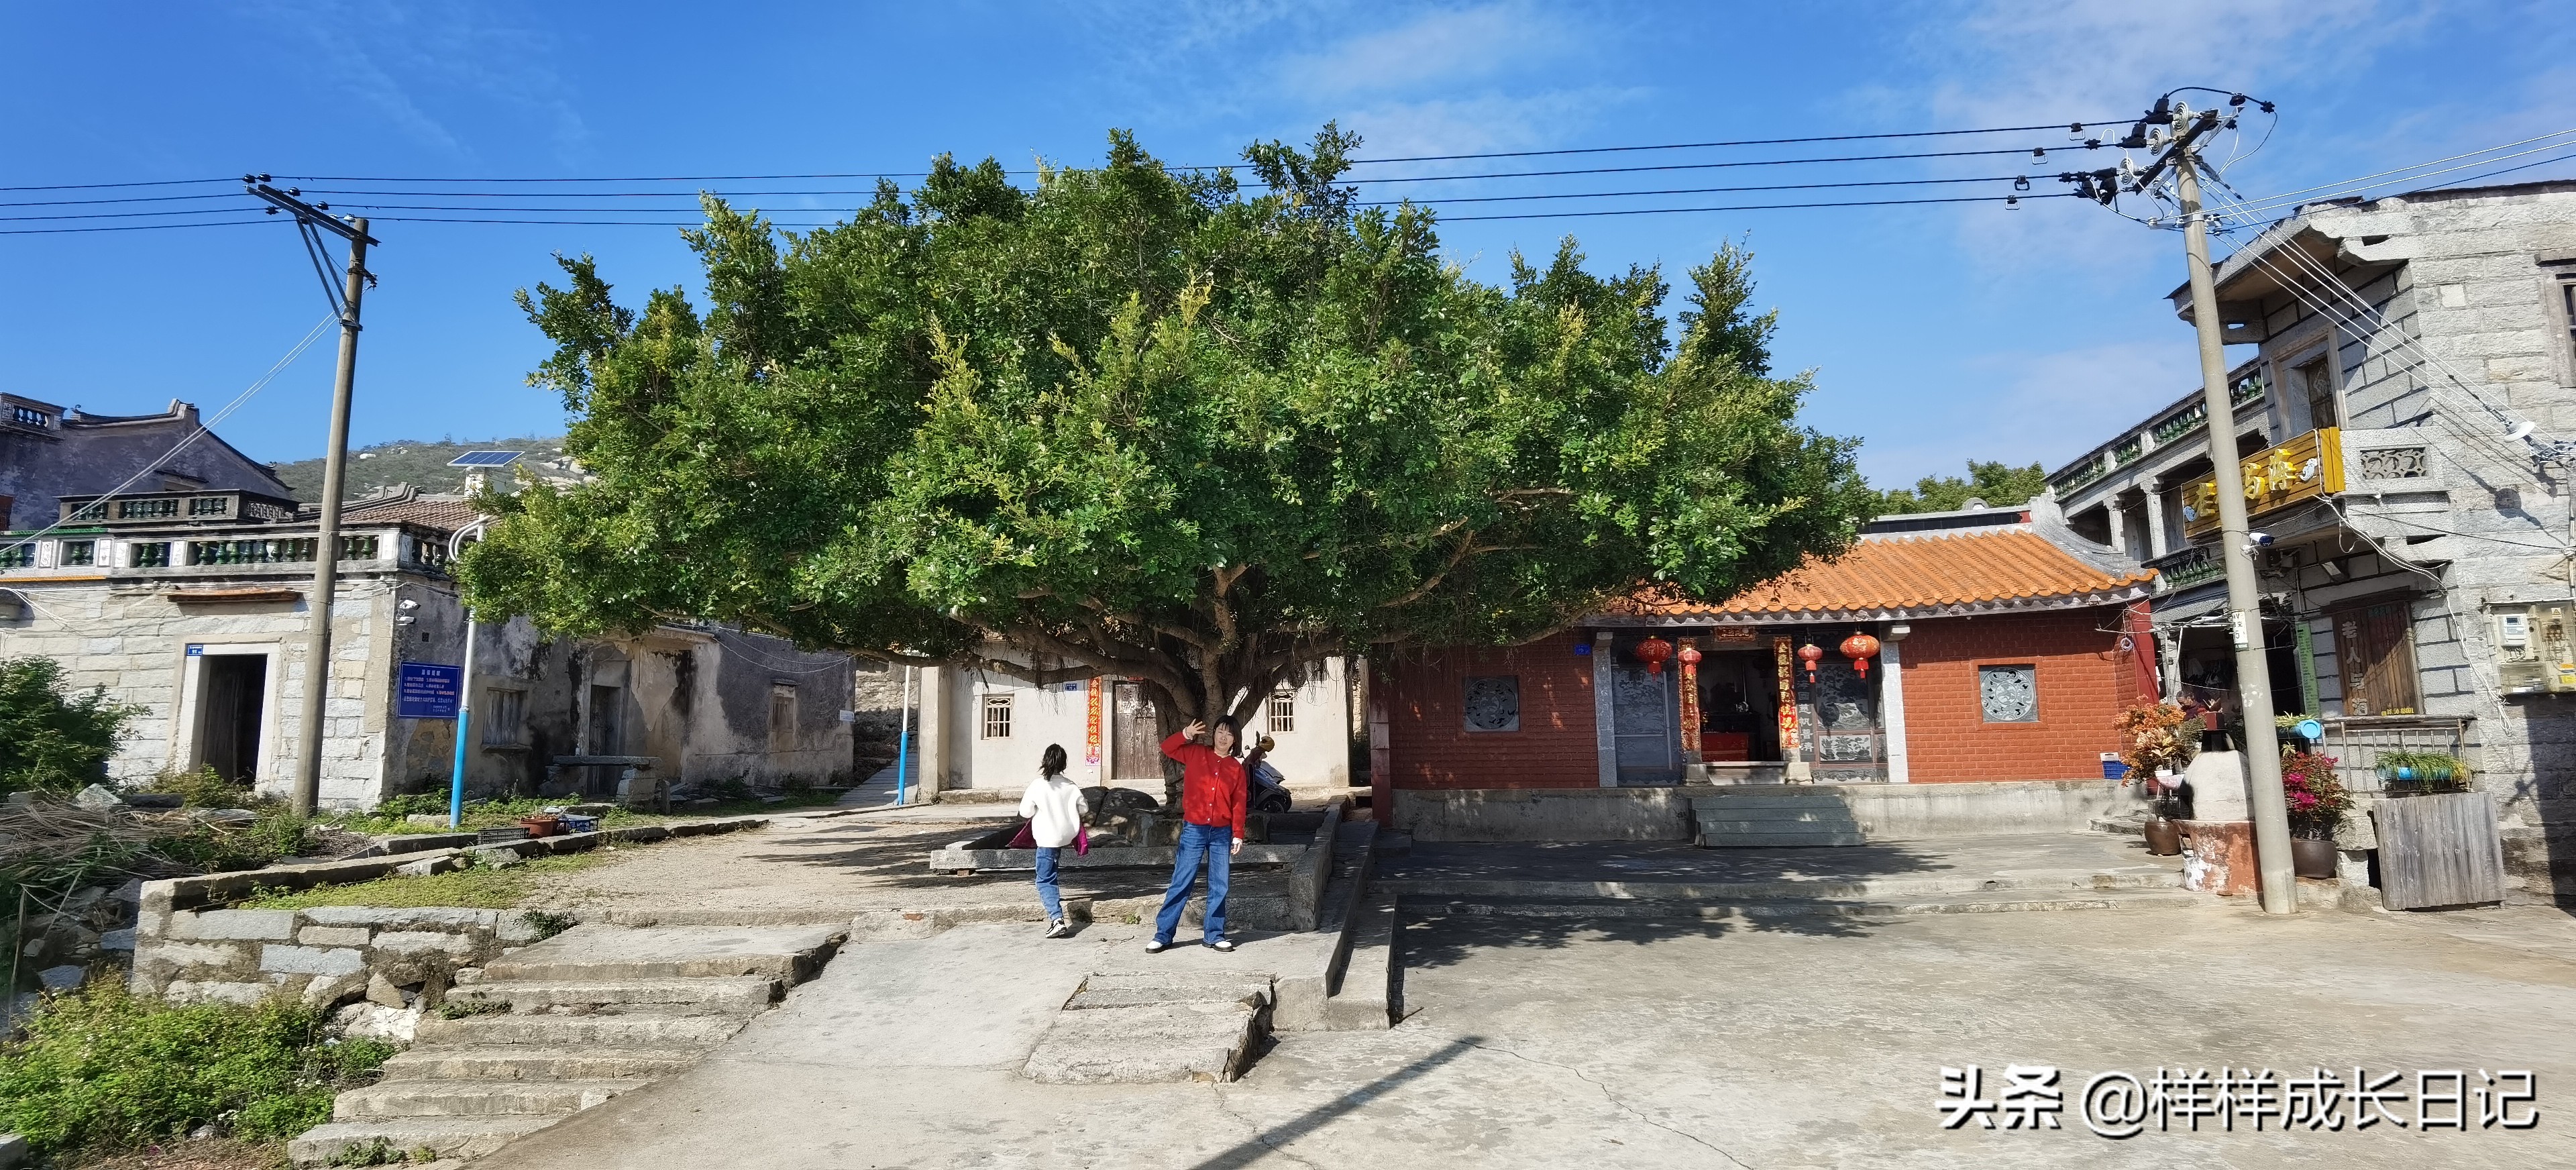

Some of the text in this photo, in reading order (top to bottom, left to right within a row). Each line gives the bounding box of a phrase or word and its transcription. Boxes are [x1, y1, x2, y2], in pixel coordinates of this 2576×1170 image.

[2191, 448, 2297, 517] 老与海
[2341, 621, 2368, 716] 老人与海
